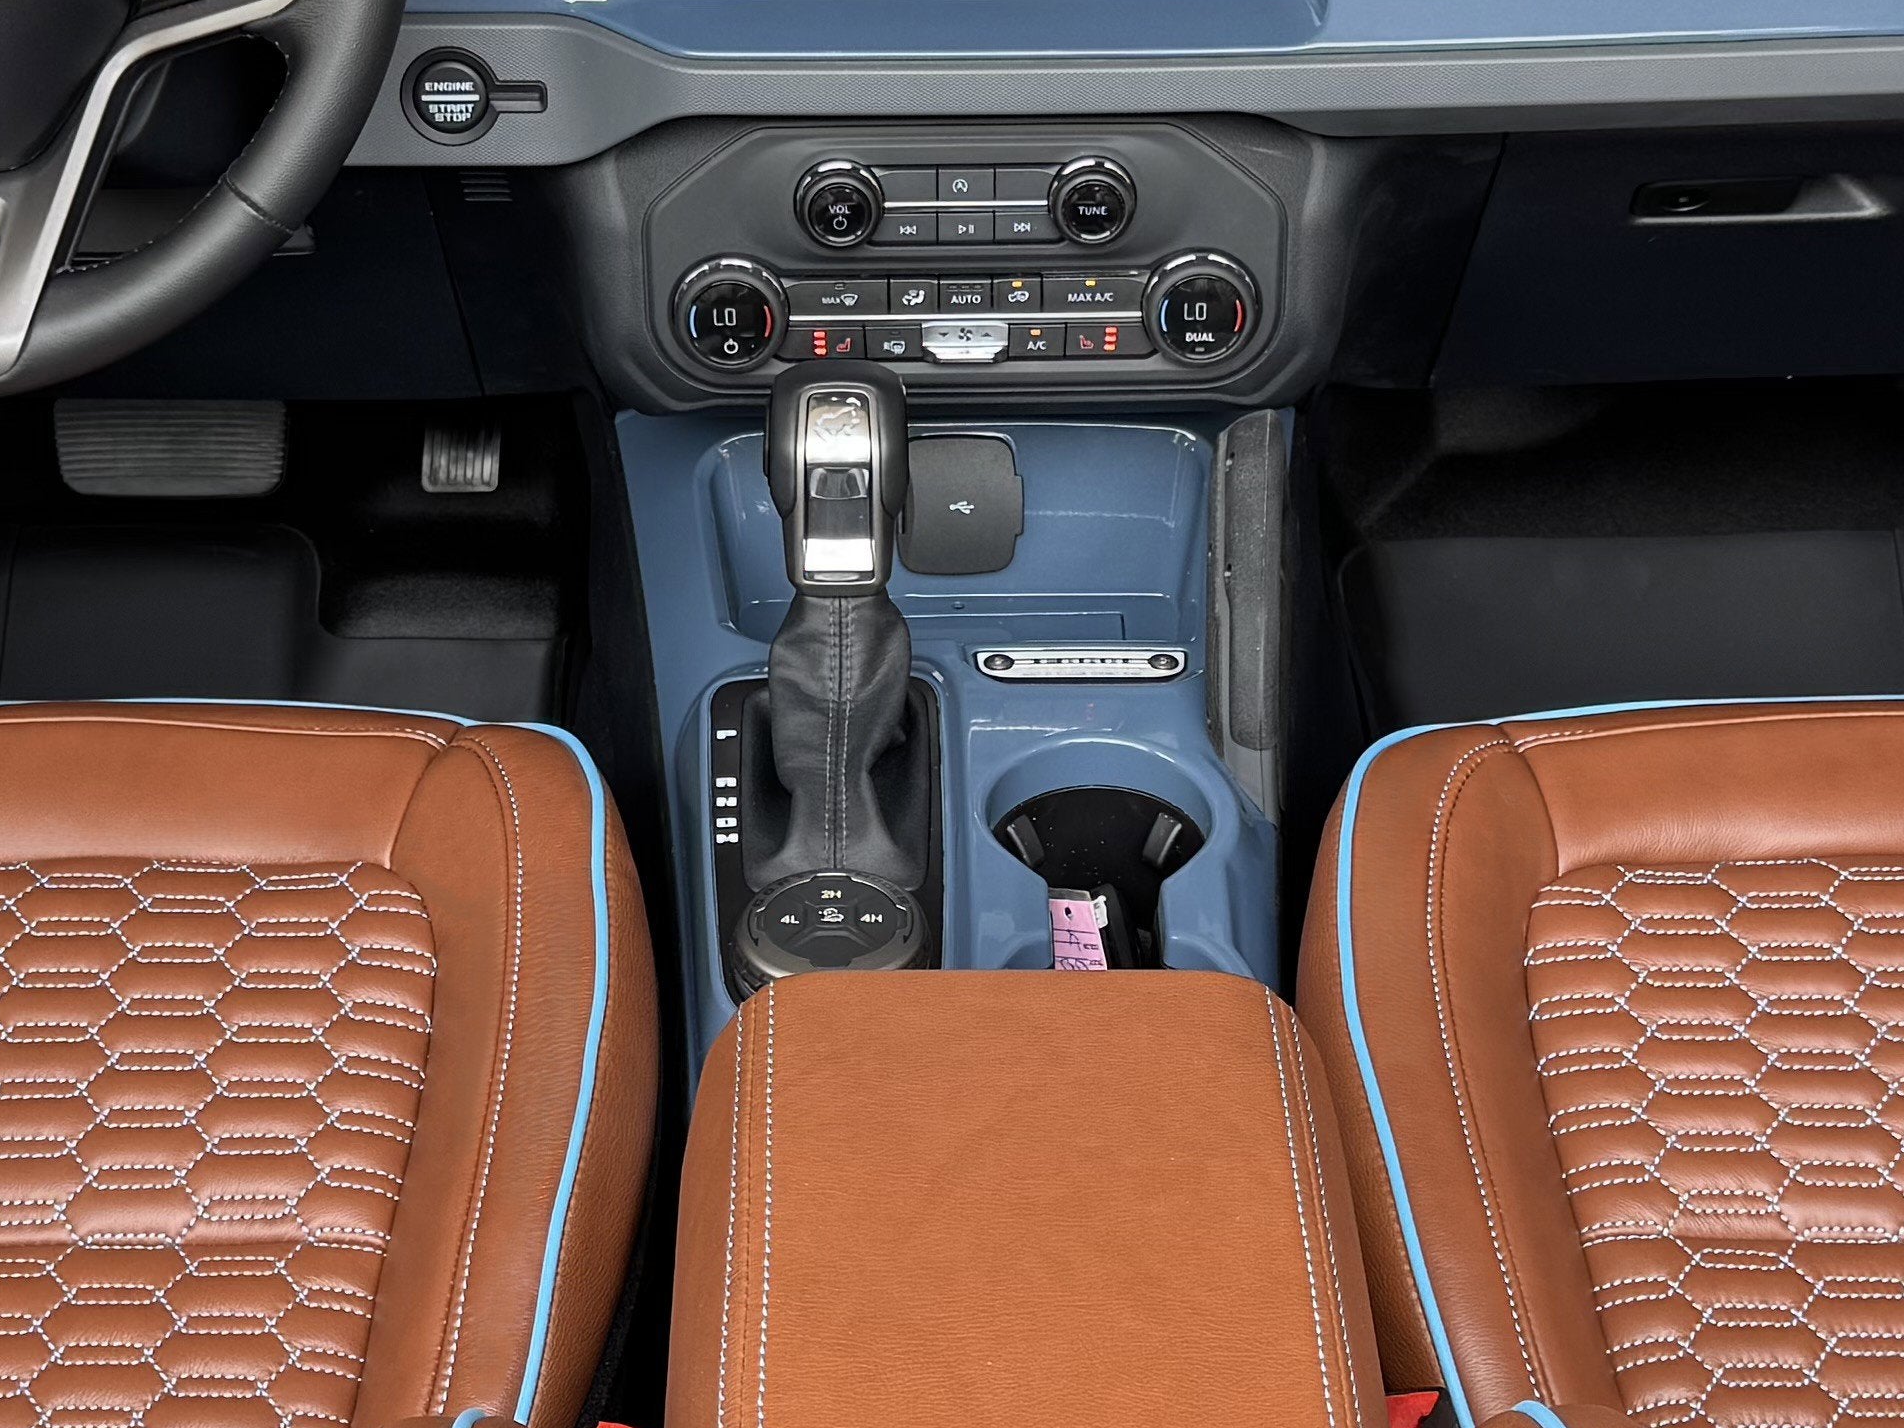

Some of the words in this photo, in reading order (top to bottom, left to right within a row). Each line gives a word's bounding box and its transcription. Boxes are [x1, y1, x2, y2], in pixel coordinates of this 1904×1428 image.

[424, 81, 475, 92] ENGINE
[428, 103, 475, 114] START
[434, 113, 472, 122] STOP
[828, 203, 852, 215] VOL
[1078, 205, 1108, 216] TUNE
[821, 296, 841, 306] MAX
[950, 293, 982, 305] AUTO
[1067, 292, 1093, 303] MAX
[1095, 291, 1114, 303] A/C
[712, 307, 737, 327] LO
[1183, 302, 1208, 321] LO
[1185, 331, 1216, 343] DUAL
[1027, 340, 1047, 351] A/C
[821, 889, 842, 900] 2H
[780, 914, 800, 925] 4L
[859, 913, 883, 924] 4H
